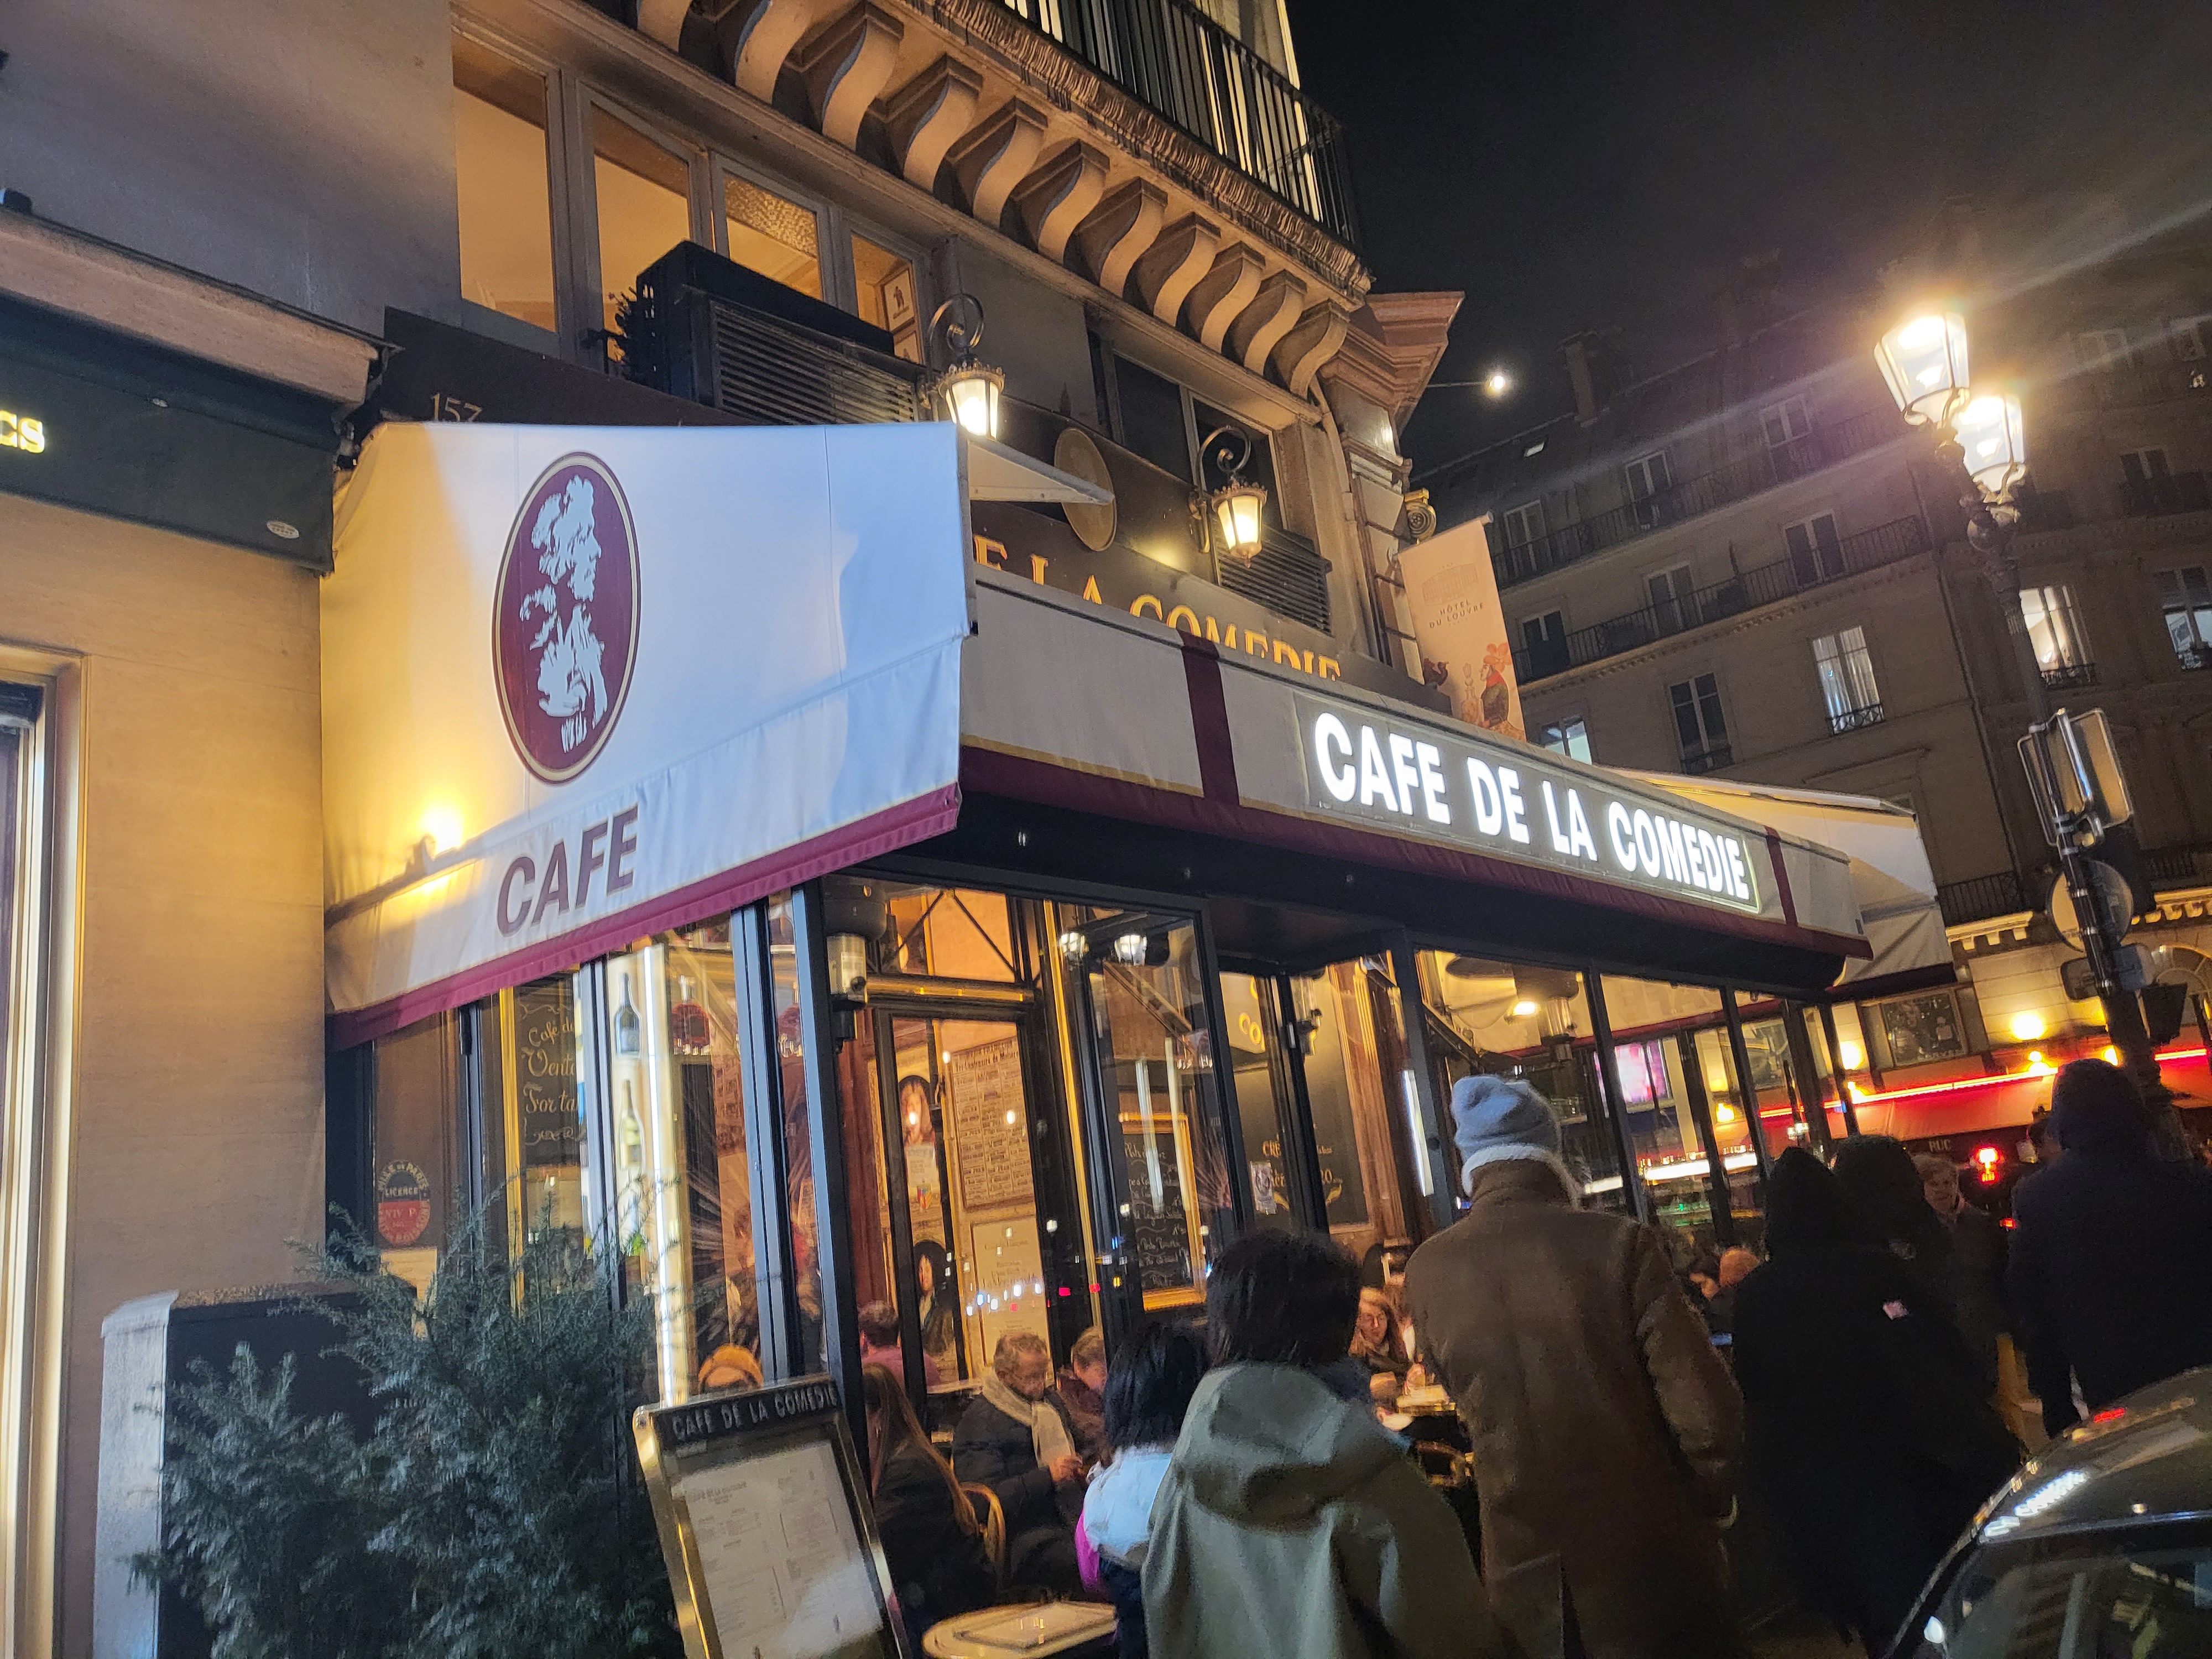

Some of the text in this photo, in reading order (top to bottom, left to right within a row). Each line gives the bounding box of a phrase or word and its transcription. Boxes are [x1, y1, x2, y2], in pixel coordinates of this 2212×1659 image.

[431, 392, 482, 422] 157
[1429, 619, 1442, 629] DU
[1447, 602, 1484, 622] LOUVRE
[1314, 712, 1750, 900] CAFE DE LA COMEDIE
[497, 804, 639, 936] CAFE
[672, 1383, 838, 1440] CAFE DE LA COMEDIE
